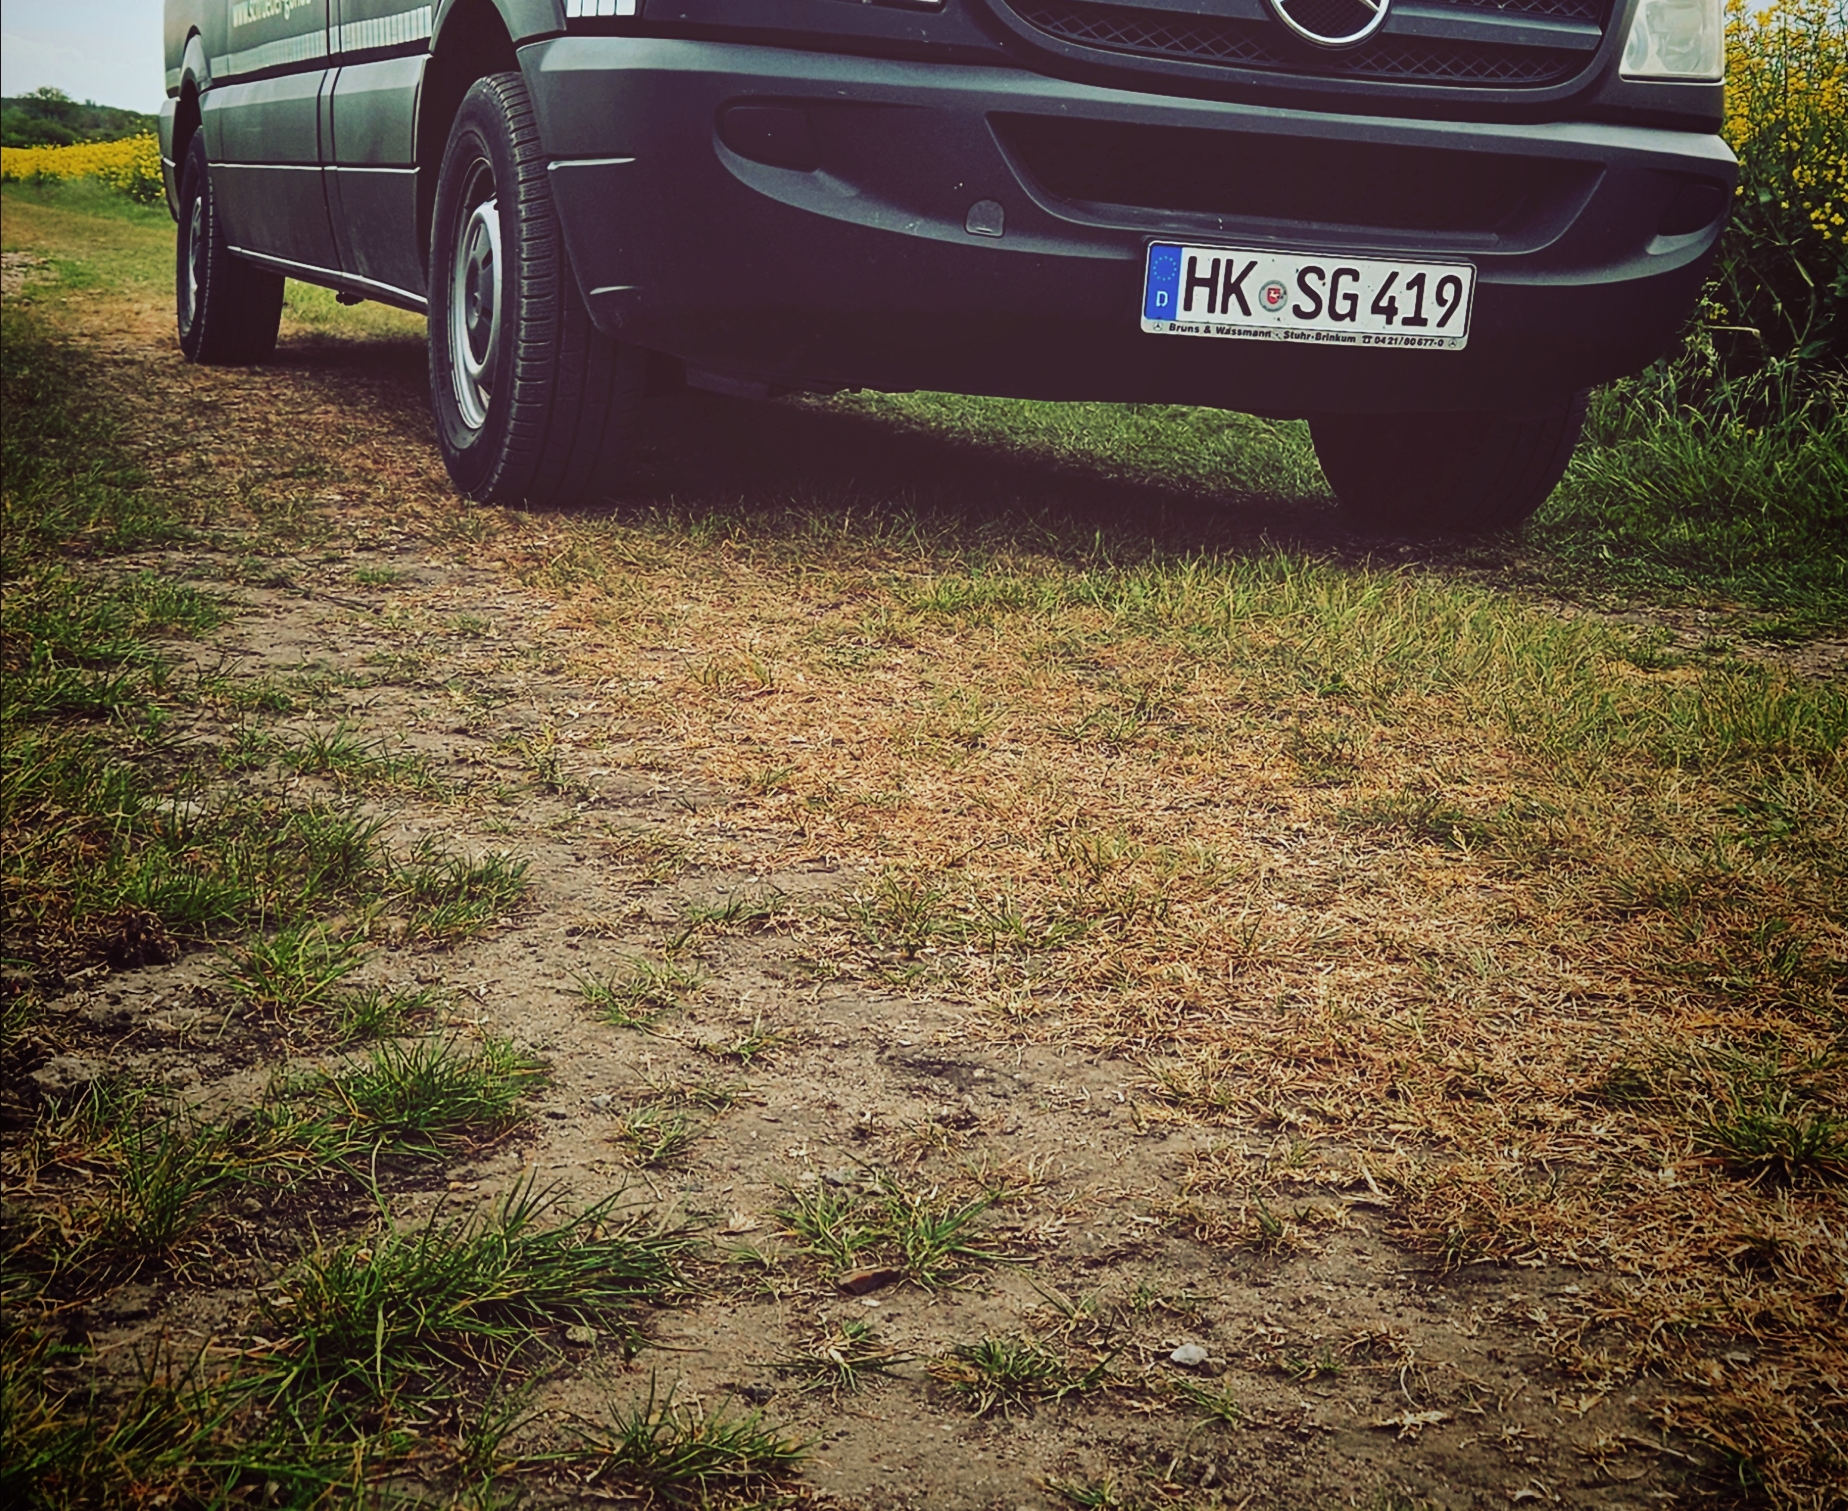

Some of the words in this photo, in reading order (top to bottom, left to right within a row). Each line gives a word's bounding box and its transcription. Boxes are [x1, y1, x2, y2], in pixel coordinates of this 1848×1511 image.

[1155, 291, 1168, 307] D
[1183, 256, 1258, 316] HK
[1292, 265, 1360, 322] SG
[1370, 271, 1463, 328] 419
[1169, 323, 1200, 333] Bruns
[1203, 325, 1211, 334] &
